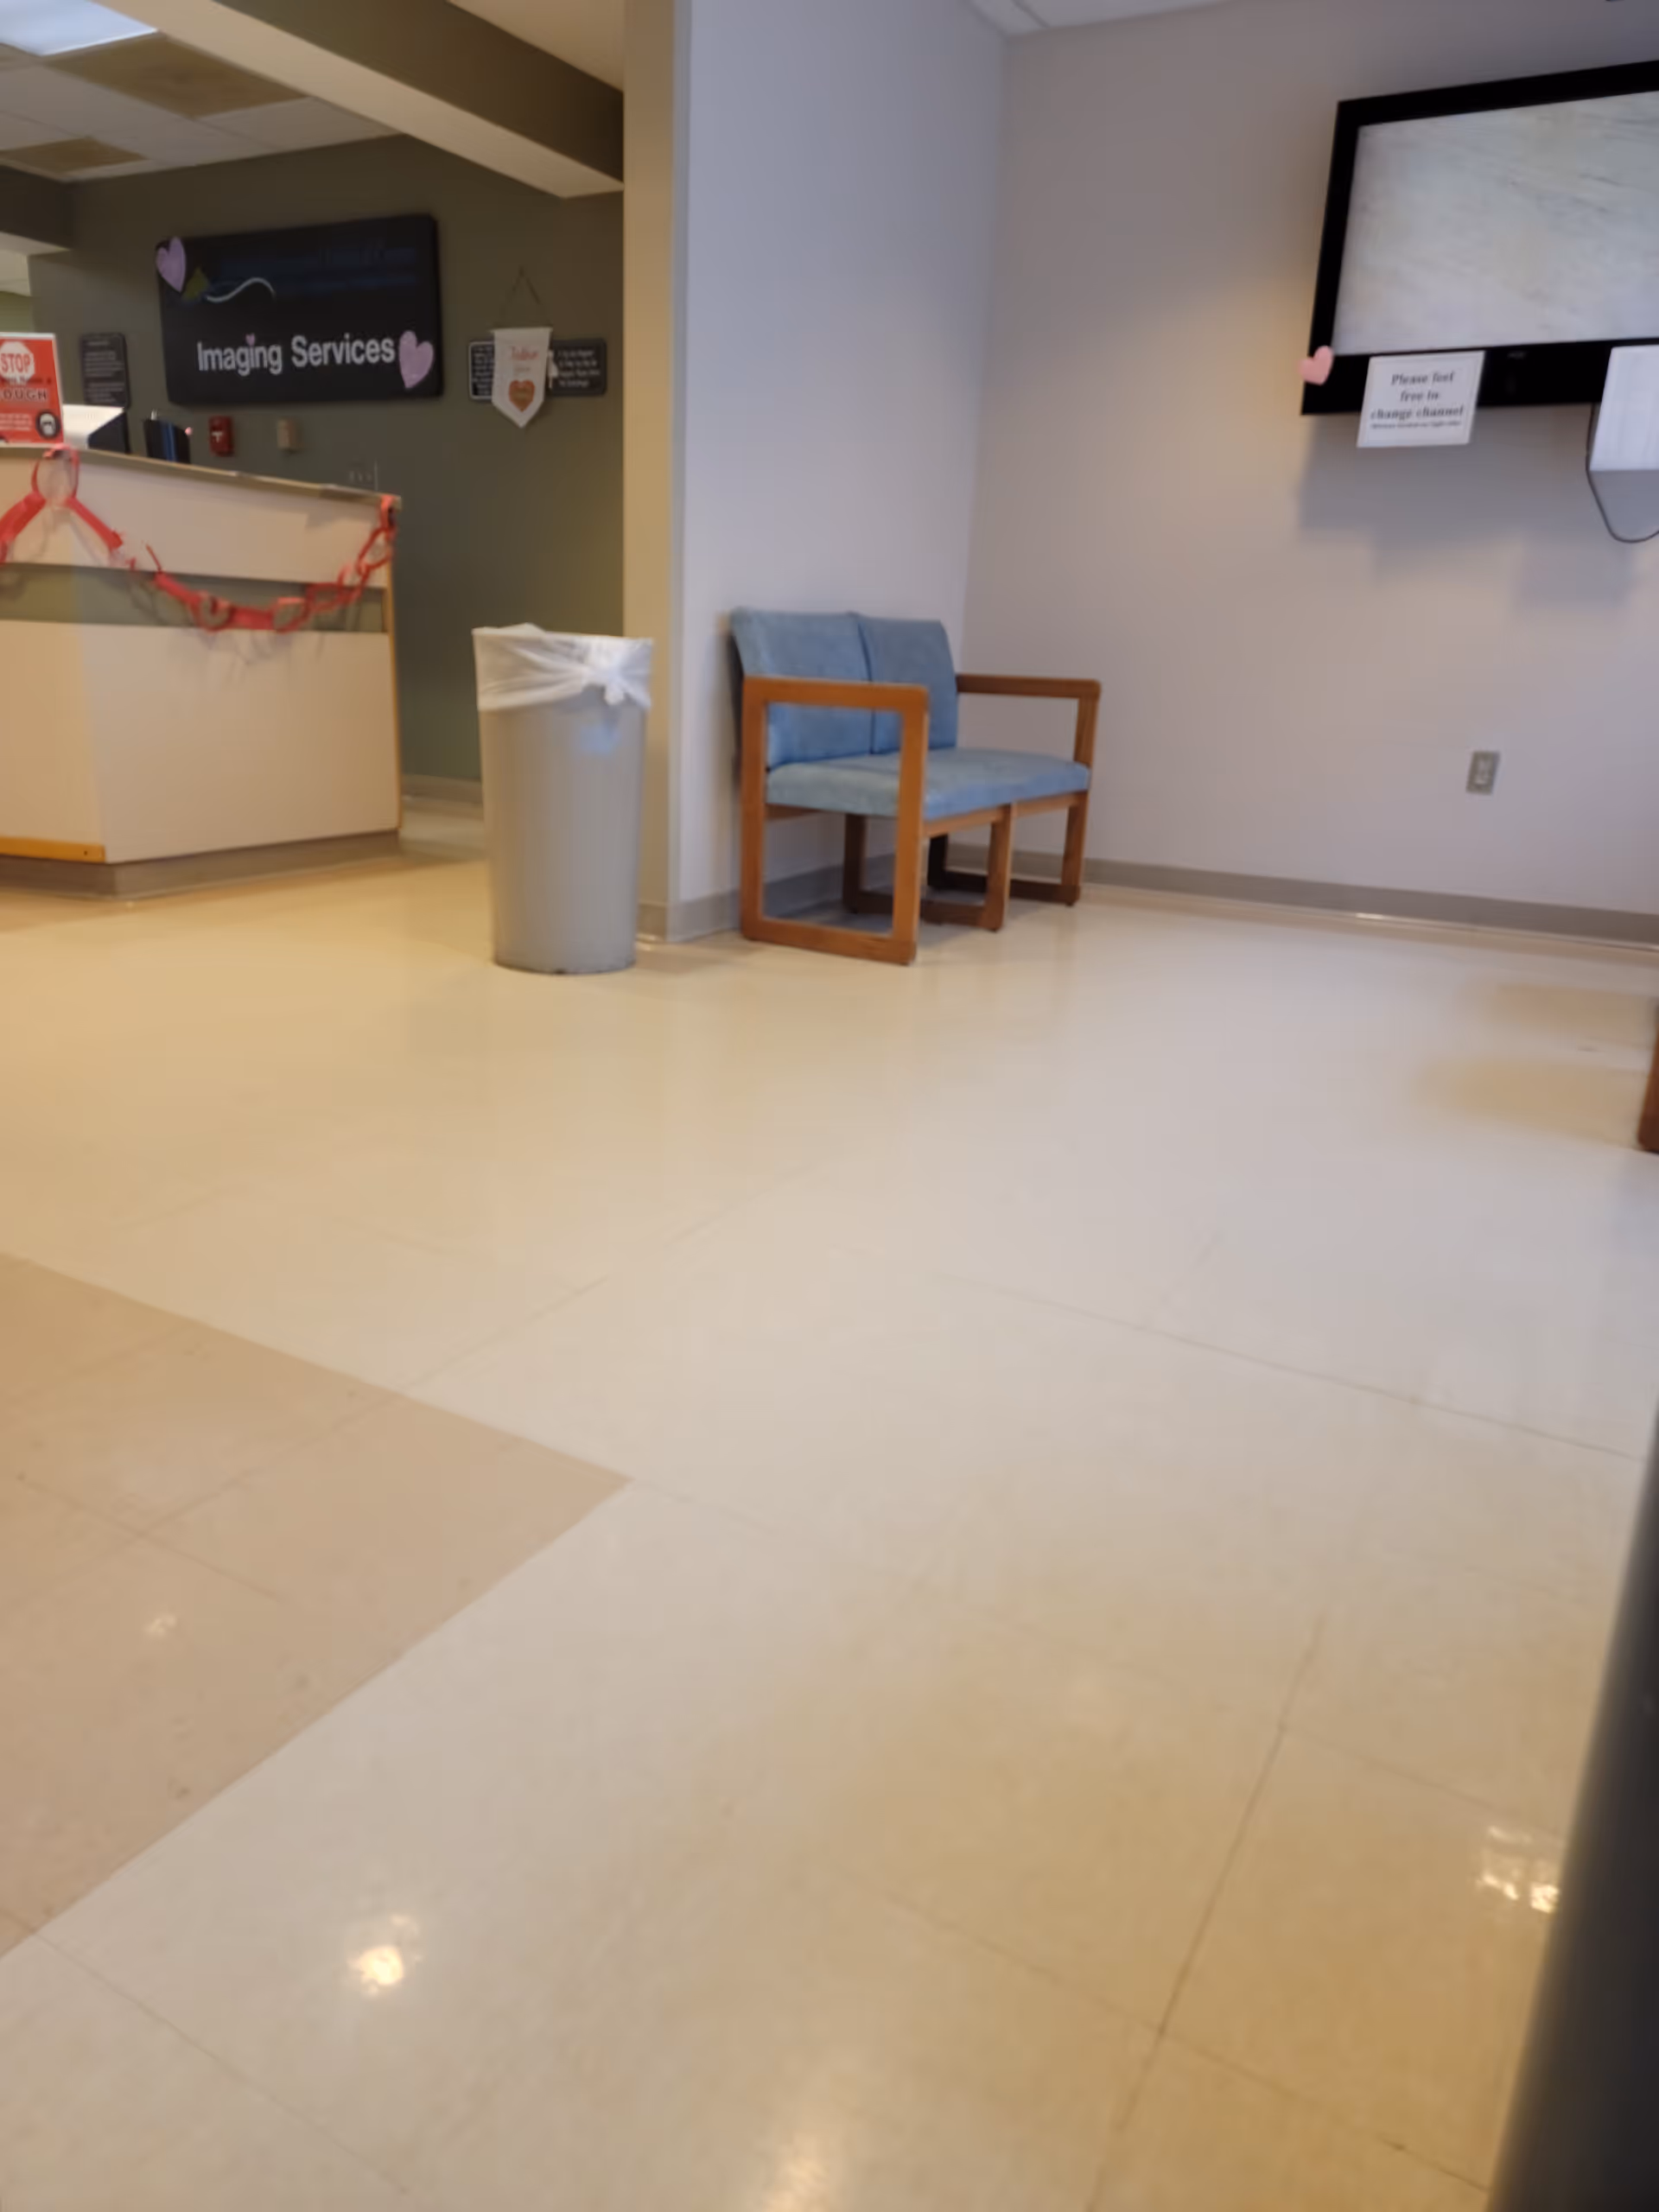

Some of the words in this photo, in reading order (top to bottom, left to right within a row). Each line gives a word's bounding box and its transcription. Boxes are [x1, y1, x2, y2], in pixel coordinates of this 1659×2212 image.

[197, 340, 283, 377] Imaging
[291, 333, 396, 367] Services
[1, 353, 30, 373] STOP
[1391, 372, 1428, 385] Please
[1432, 371, 1456, 385] feel
[2, 388, 48, 400] OUGH
[1400, 390, 1424, 403] free
[1370, 408, 1413, 421] change
[1415, 406, 1465, 418] channel
